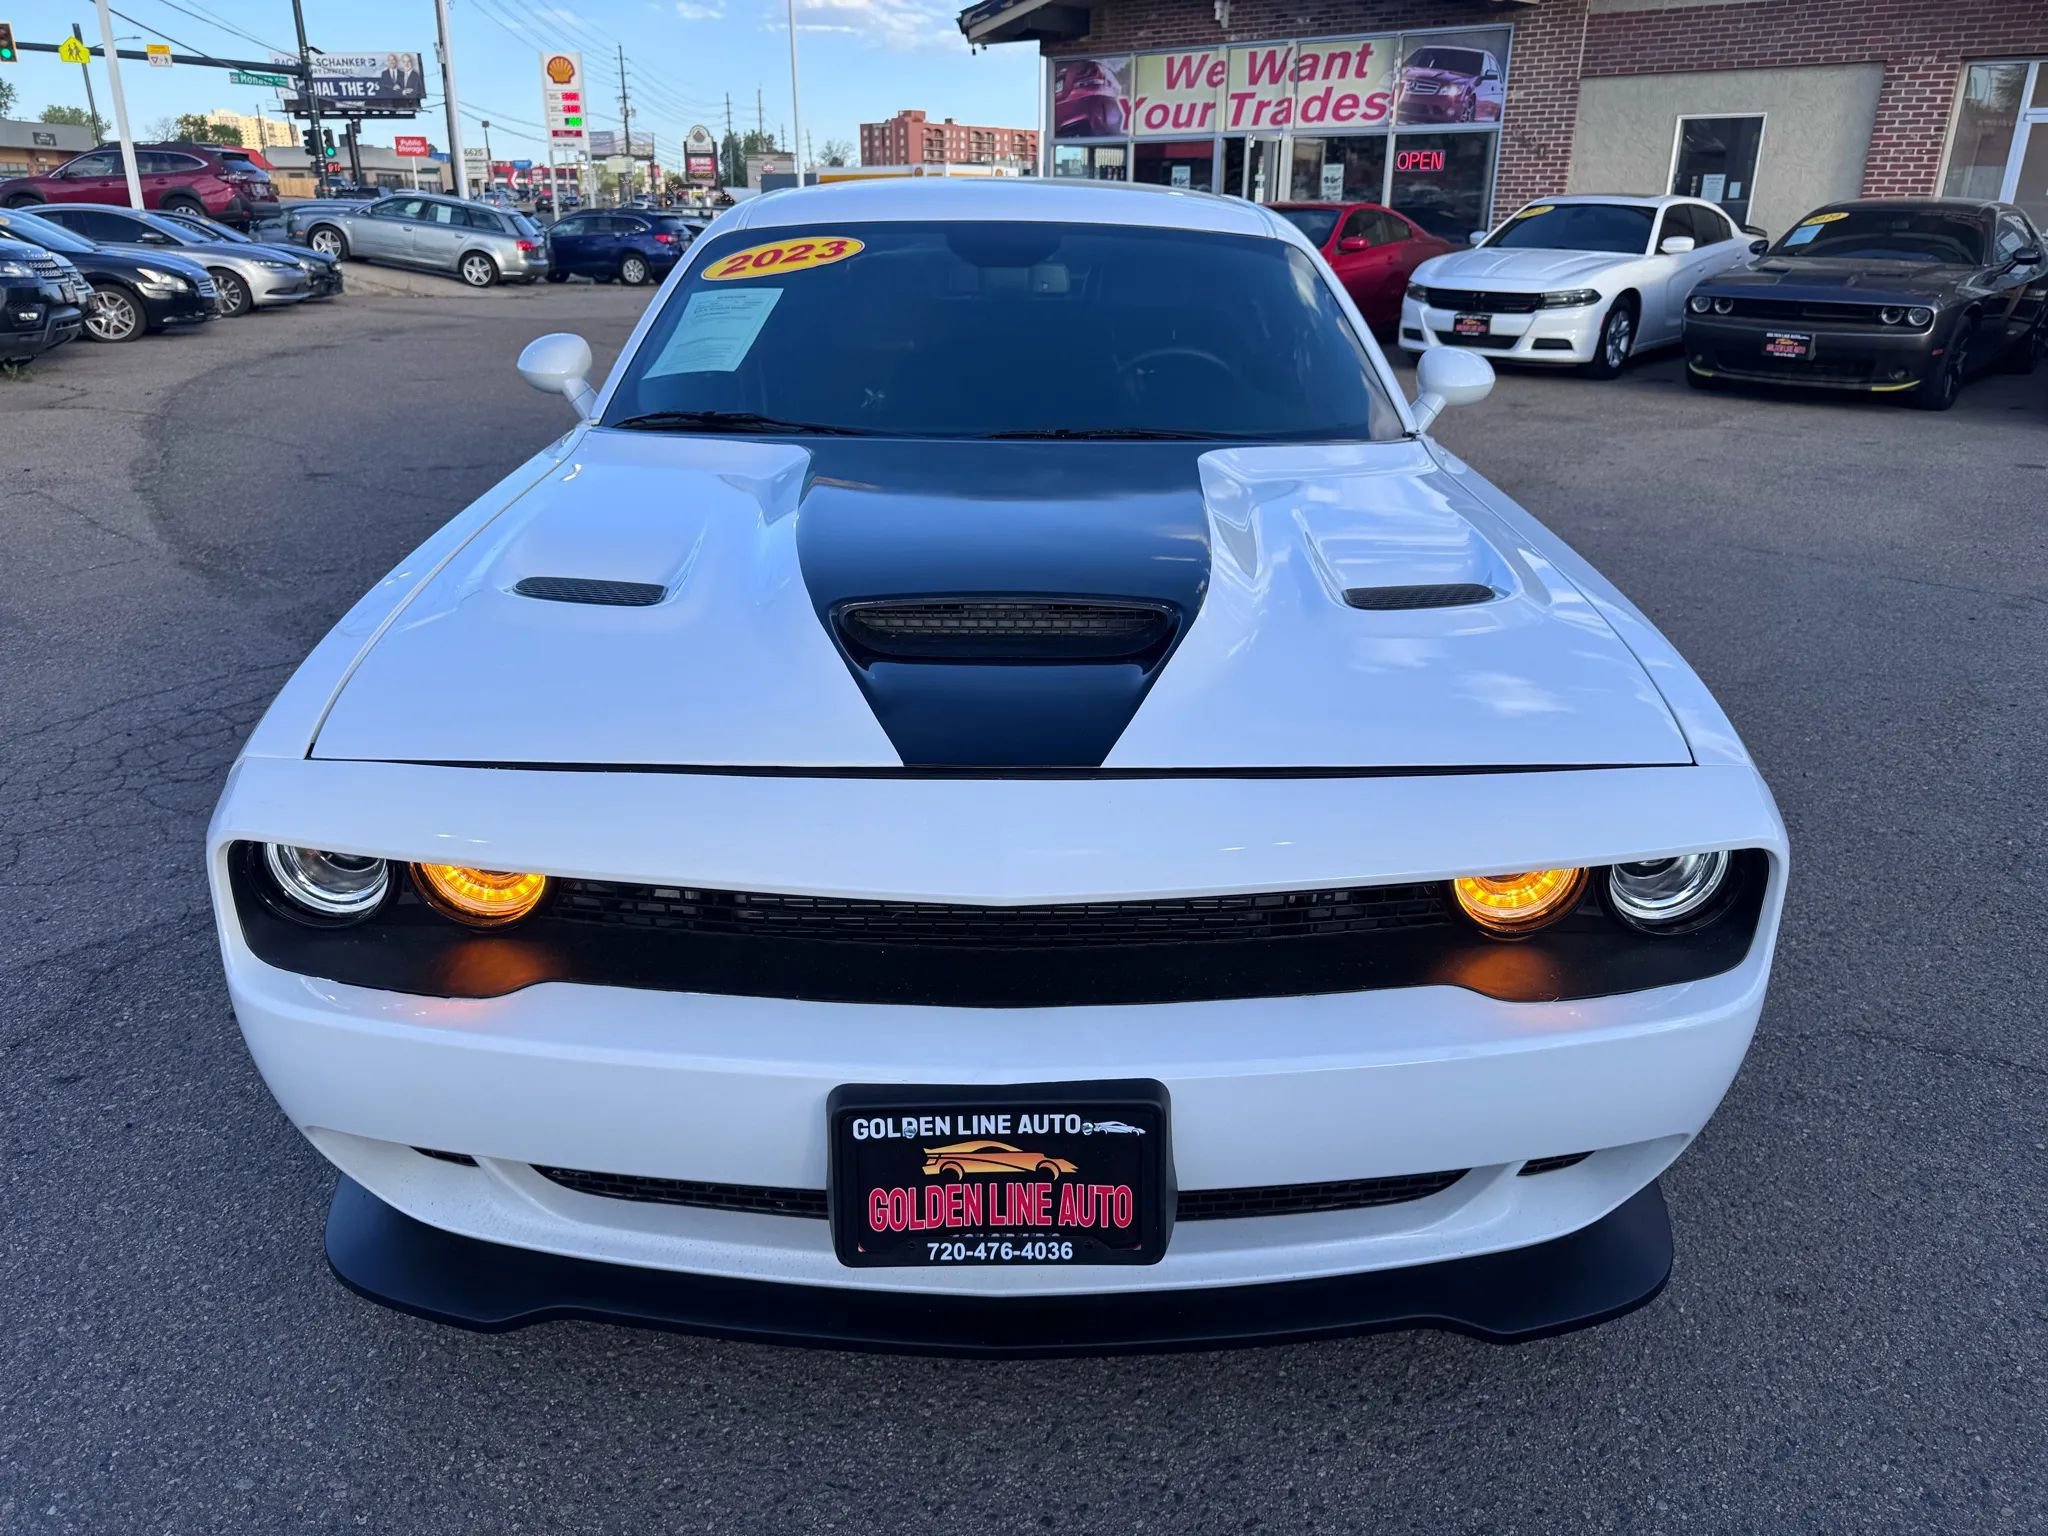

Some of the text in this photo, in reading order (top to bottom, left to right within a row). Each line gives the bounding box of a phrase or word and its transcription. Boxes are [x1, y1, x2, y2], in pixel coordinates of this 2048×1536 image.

[316, 57, 367, 67] SCHANKER
[1165, 42, 1374, 91] We Want
[240, 73, 273, 86] Monaco
[339, 81, 365, 97] THE
[1118, 95, 1217, 130] Your
[398, 145, 425, 154] Storage
[400, 138, 422, 146] Public
[1397, 151, 1443, 170] OPEN
[718, 239, 849, 277] 2023
[852, 1113, 1081, 1140] GOLDEN LINE AUTO
[868, 1182, 1133, 1232] GOLDEN LINE AUTO
[927, 1241, 1074, 1261] 720-476-4036
